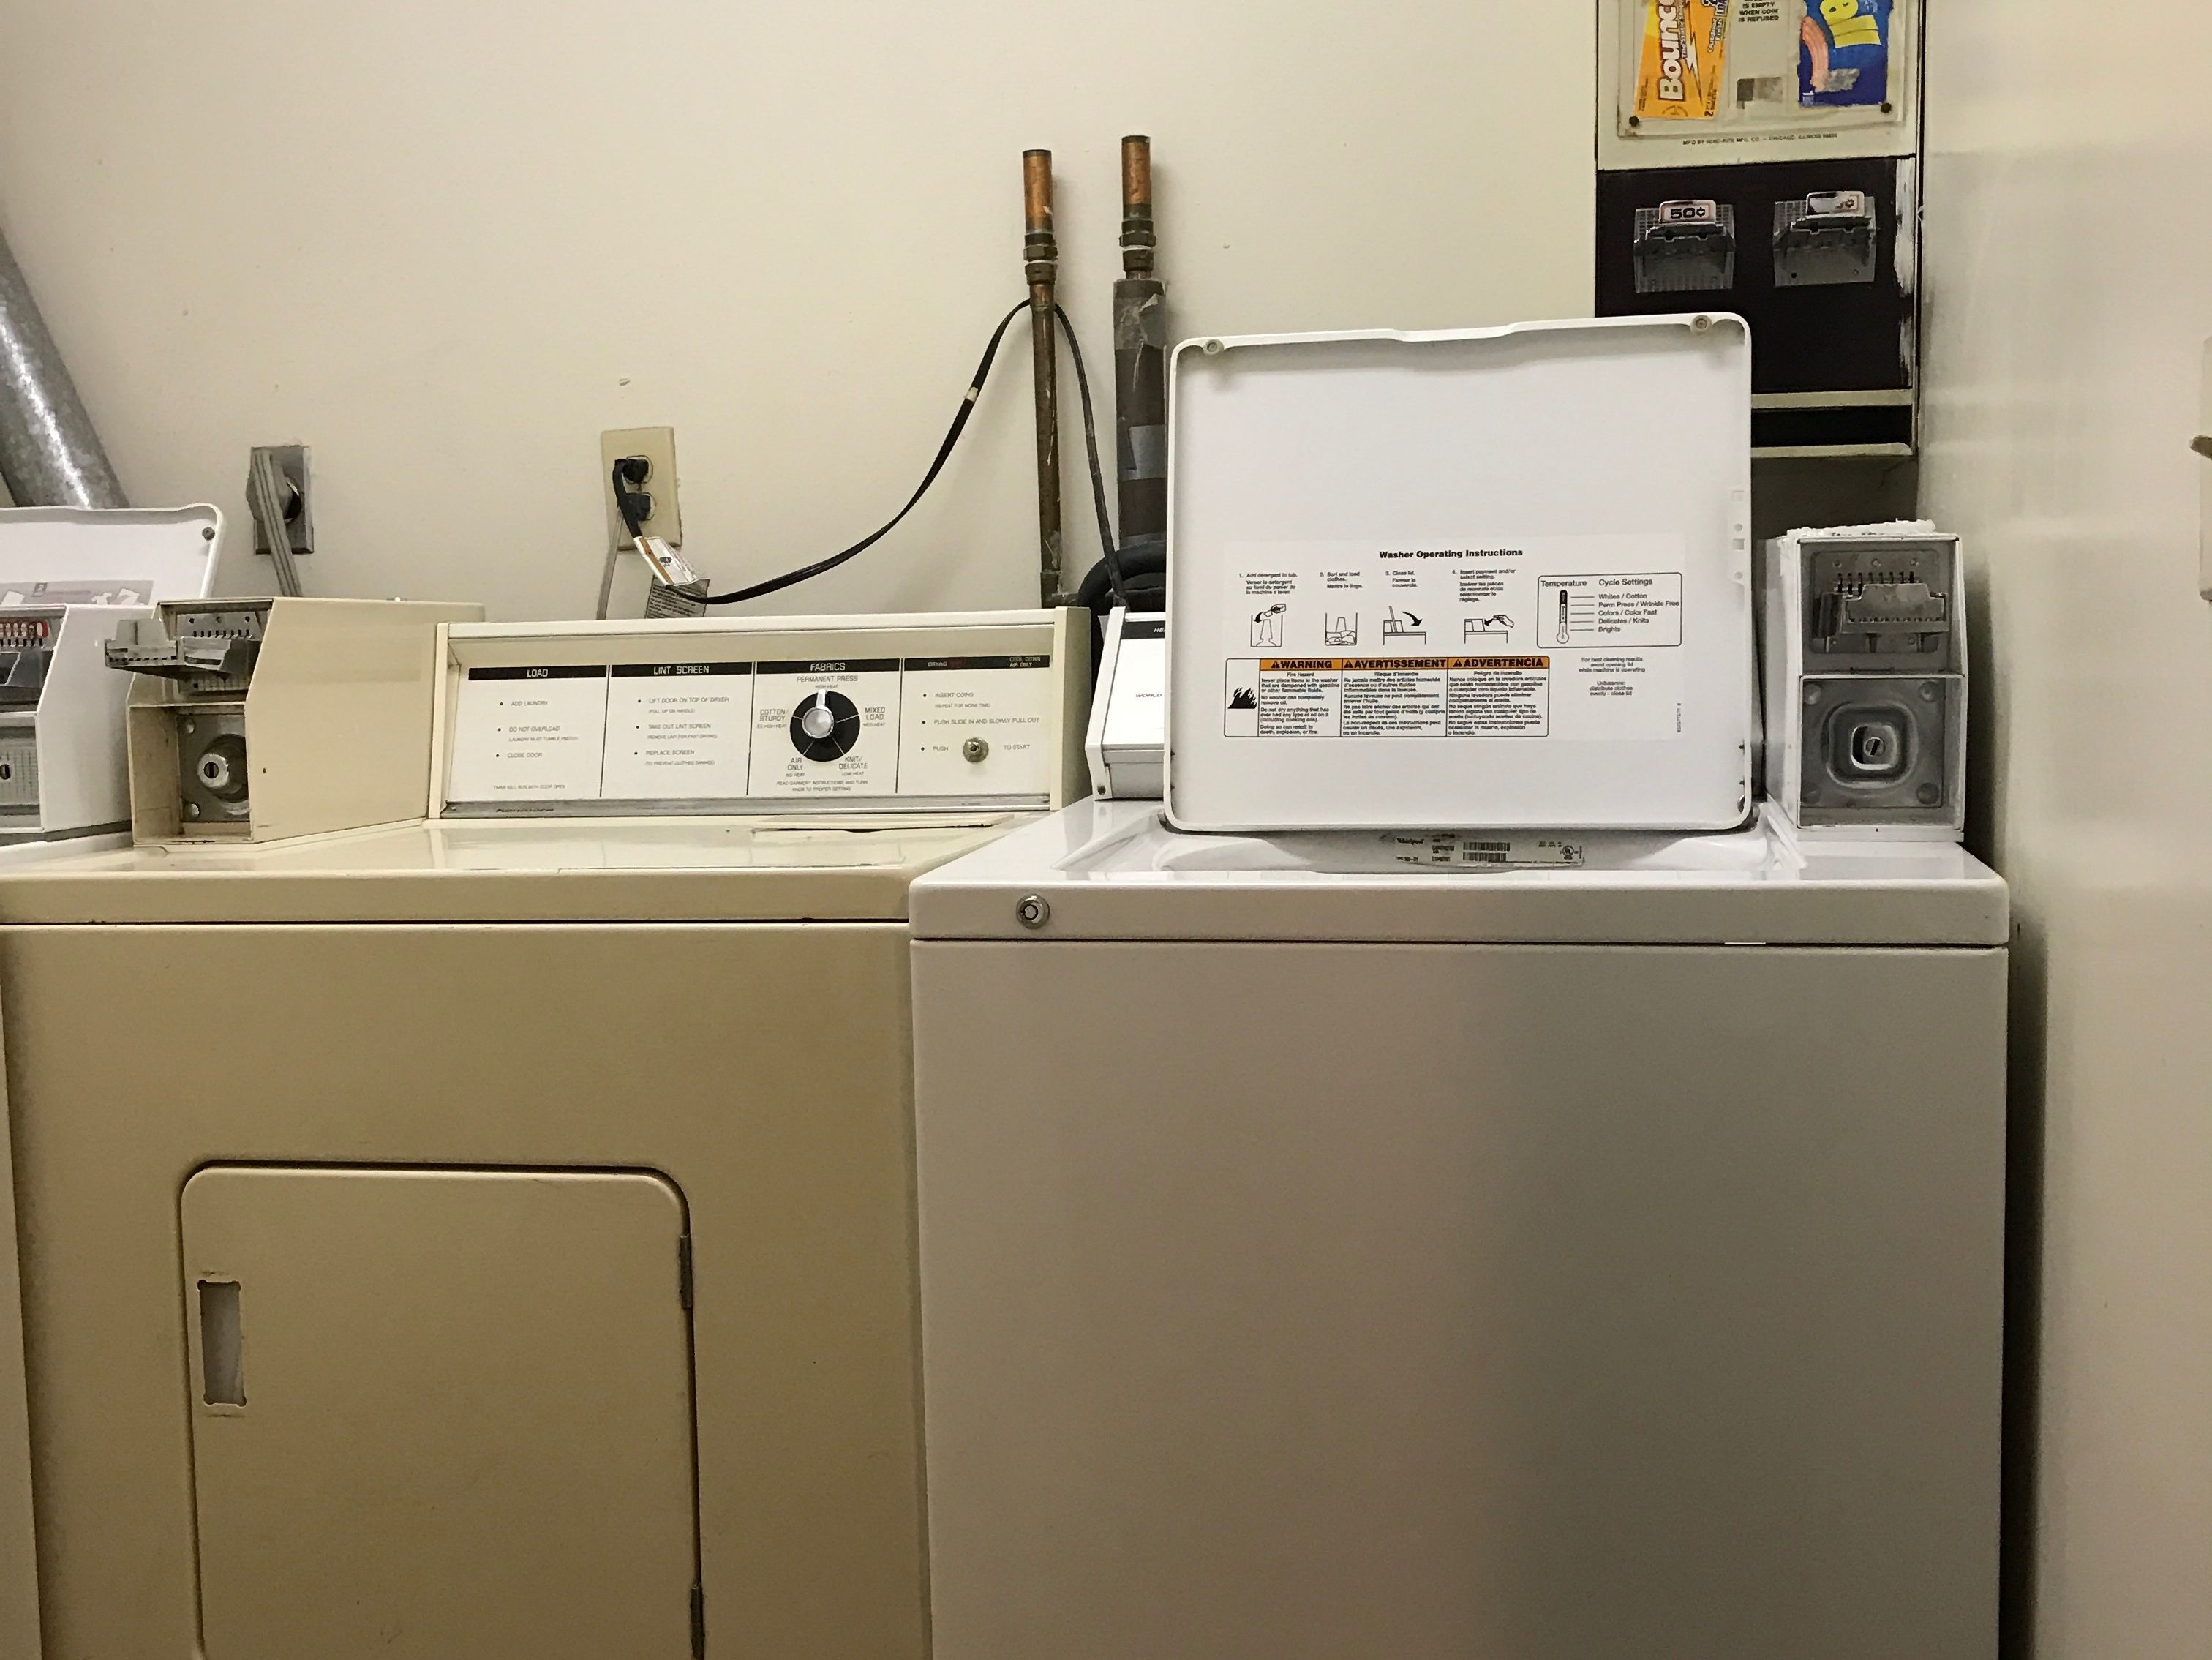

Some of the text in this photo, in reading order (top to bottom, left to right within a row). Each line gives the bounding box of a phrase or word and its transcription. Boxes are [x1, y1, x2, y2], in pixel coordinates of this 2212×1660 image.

[1671, 207, 1705, 219] 50¢
[1417, 550, 1463, 559] Operating
[1599, 578, 1653, 587] Cycle Settings
[810, 663, 845, 671] FABRICS
[1354, 660, 1446, 669] AVERTISSEMENT
[1464, 658, 1544, 668] ADVERTENCIA
[527, 669, 548, 677] LOAD
[654, 665, 709, 675] LINT SCREEN
